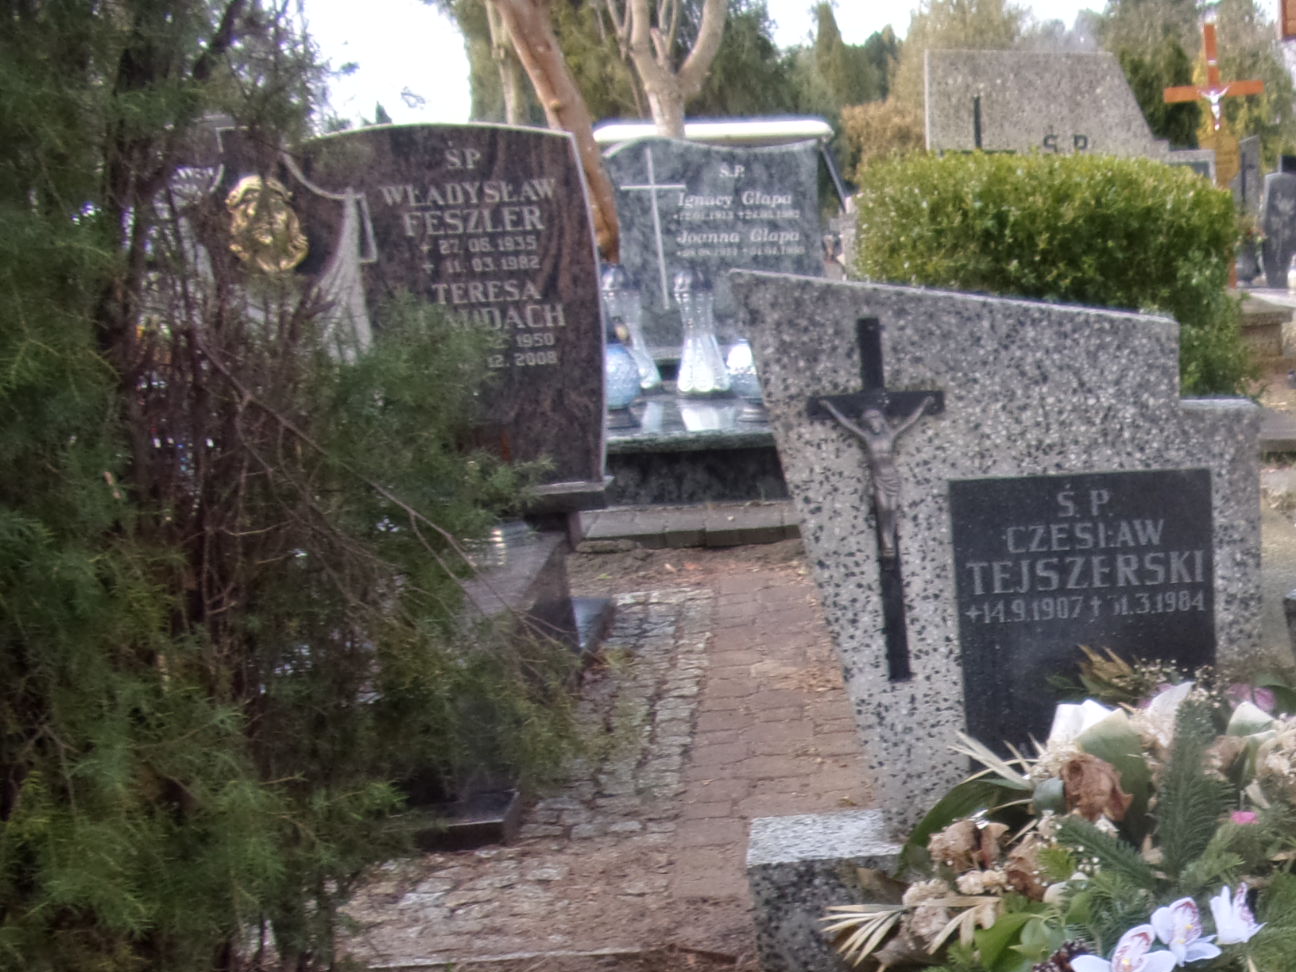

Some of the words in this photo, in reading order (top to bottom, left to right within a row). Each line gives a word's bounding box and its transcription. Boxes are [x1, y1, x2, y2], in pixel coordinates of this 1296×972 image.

[379, 178, 556, 206] WŁADYSŁAW
[741, 190, 793, 208] Glapa
[404, 205, 545, 237] FESZLER
[676, 229, 740, 244] Joanna
[750, 228, 800, 244] Glapa
[432, 279, 541, 305] TERESA
[965, 551, 1205, 595] TEJSZERSKI
